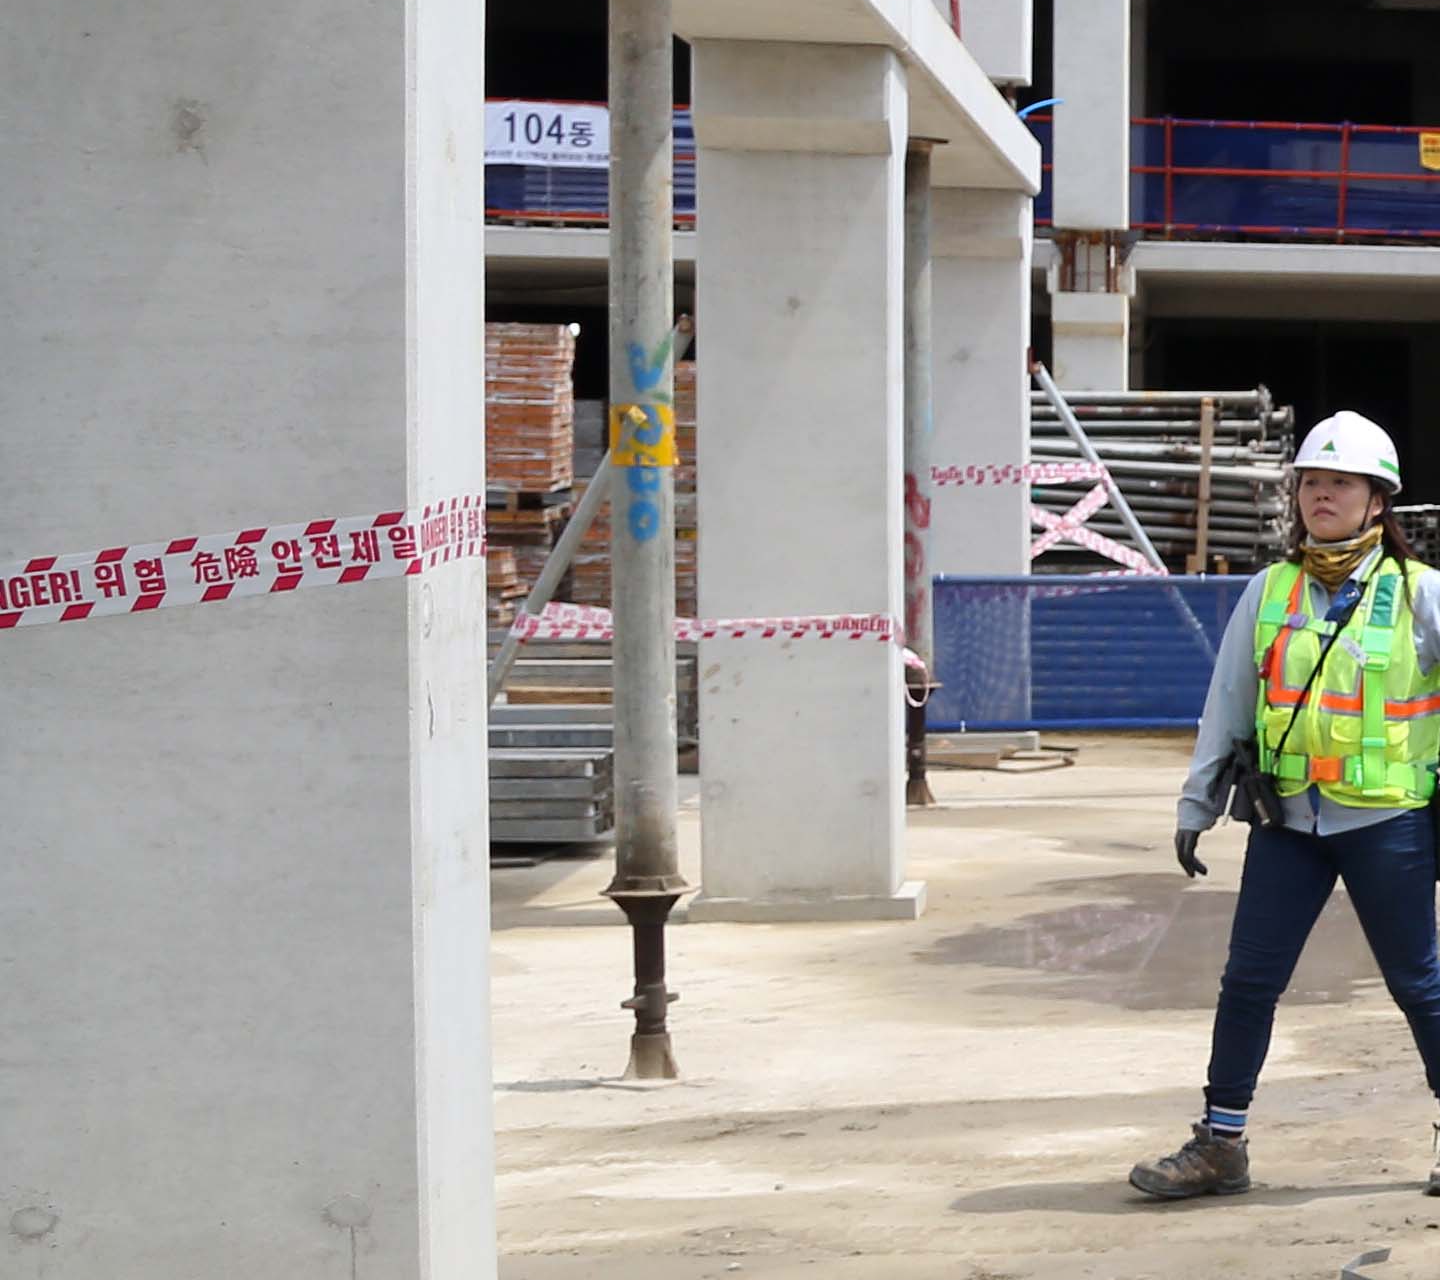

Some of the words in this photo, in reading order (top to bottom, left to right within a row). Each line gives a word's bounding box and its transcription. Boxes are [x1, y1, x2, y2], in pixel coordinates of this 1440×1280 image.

[503, 111, 595, 148] 104동
[94, 557, 167, 600] 위험
[190, 547, 260, 586] 危險
[270, 524, 418, 577] 안전제일
